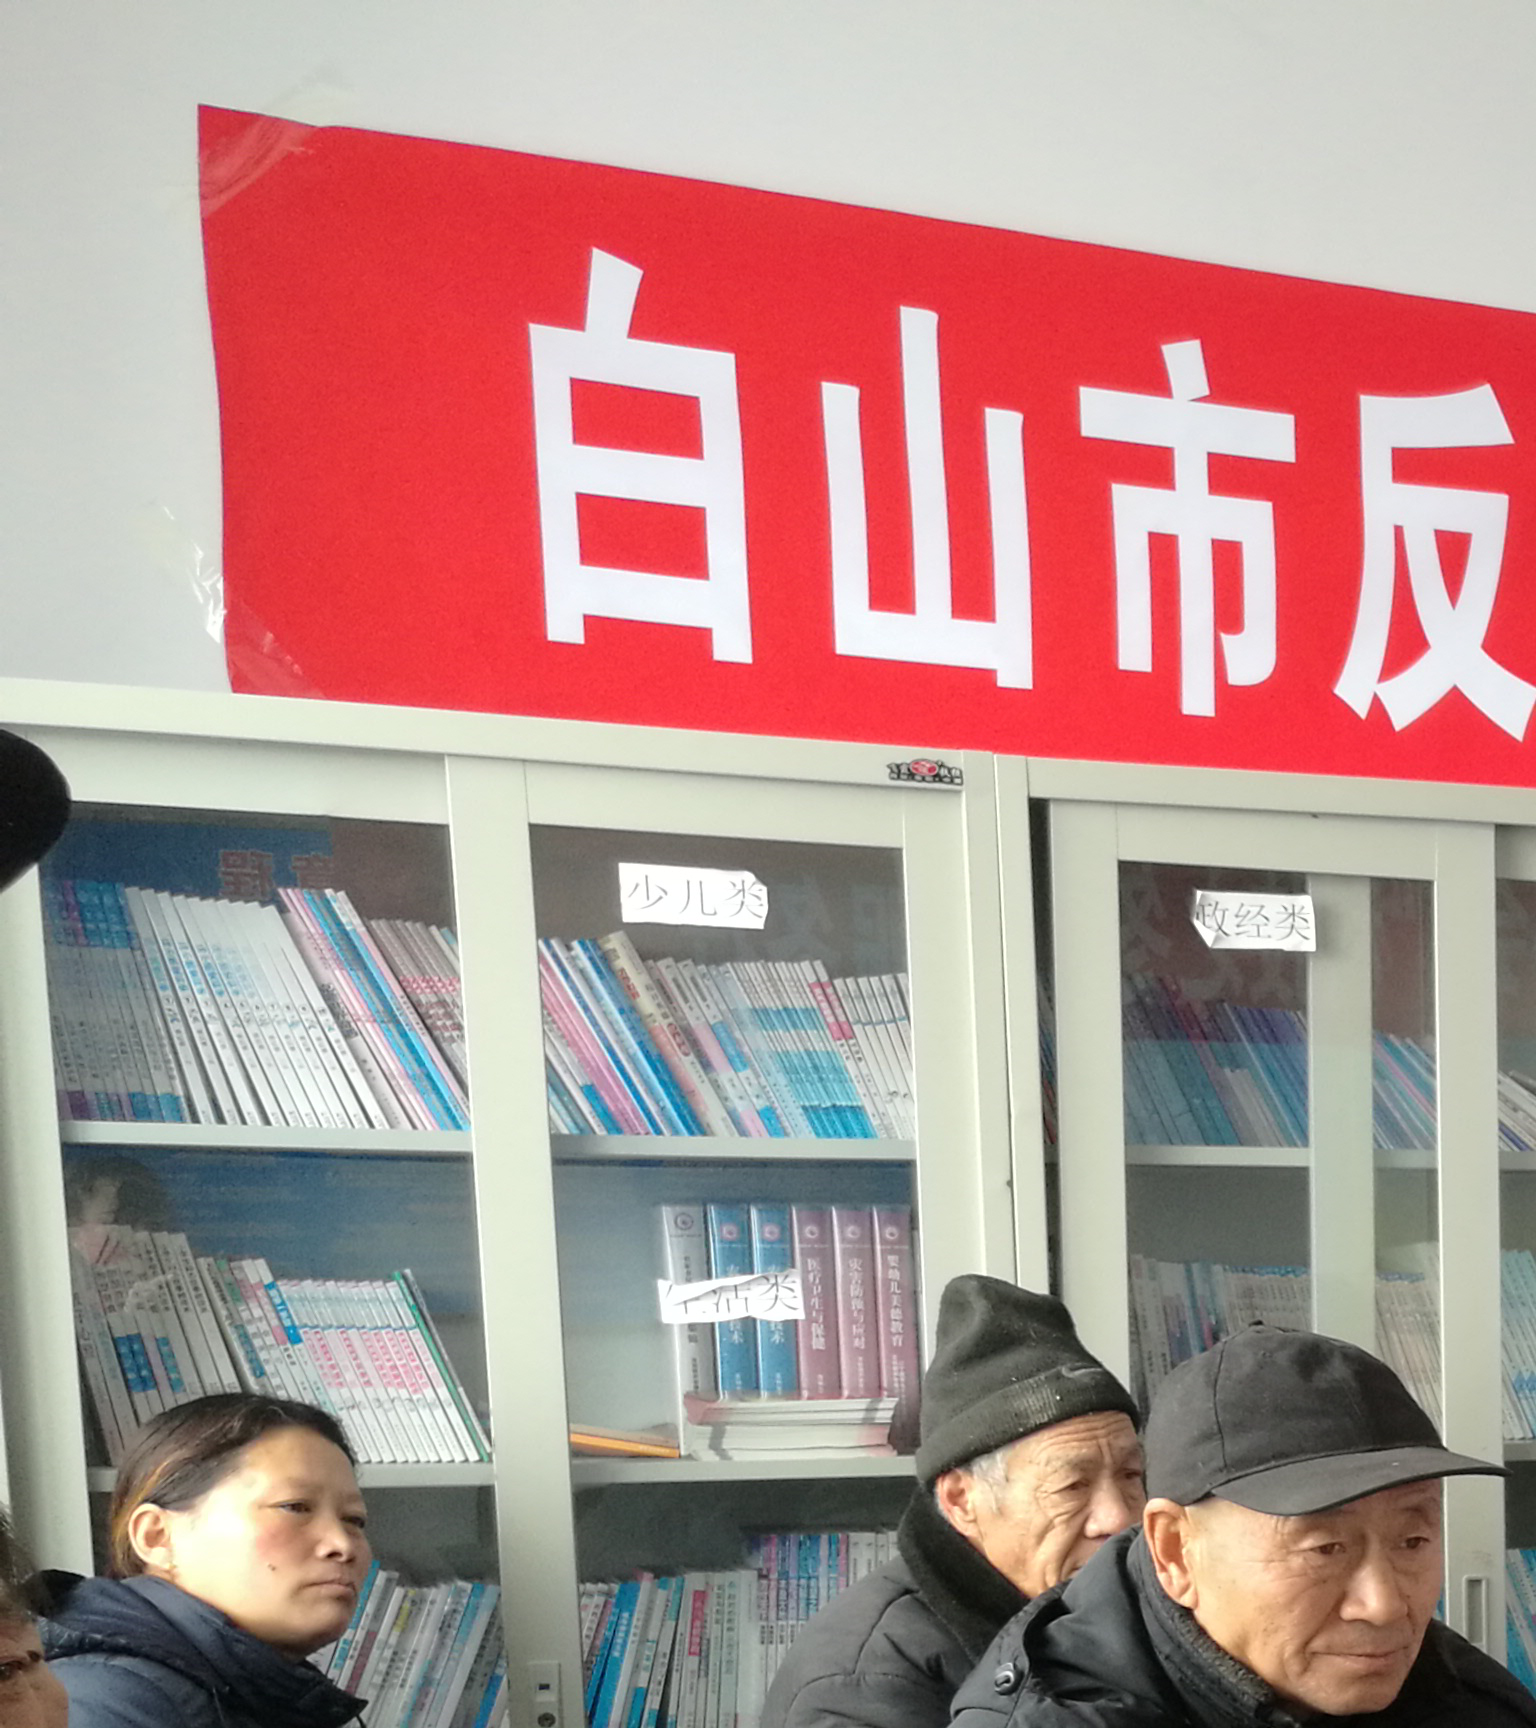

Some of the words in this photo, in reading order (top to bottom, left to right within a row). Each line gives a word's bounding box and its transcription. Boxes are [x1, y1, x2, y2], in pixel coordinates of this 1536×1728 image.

[627, 875, 765, 919] 少儿类
[1196, 900, 1311, 941] 政经类
